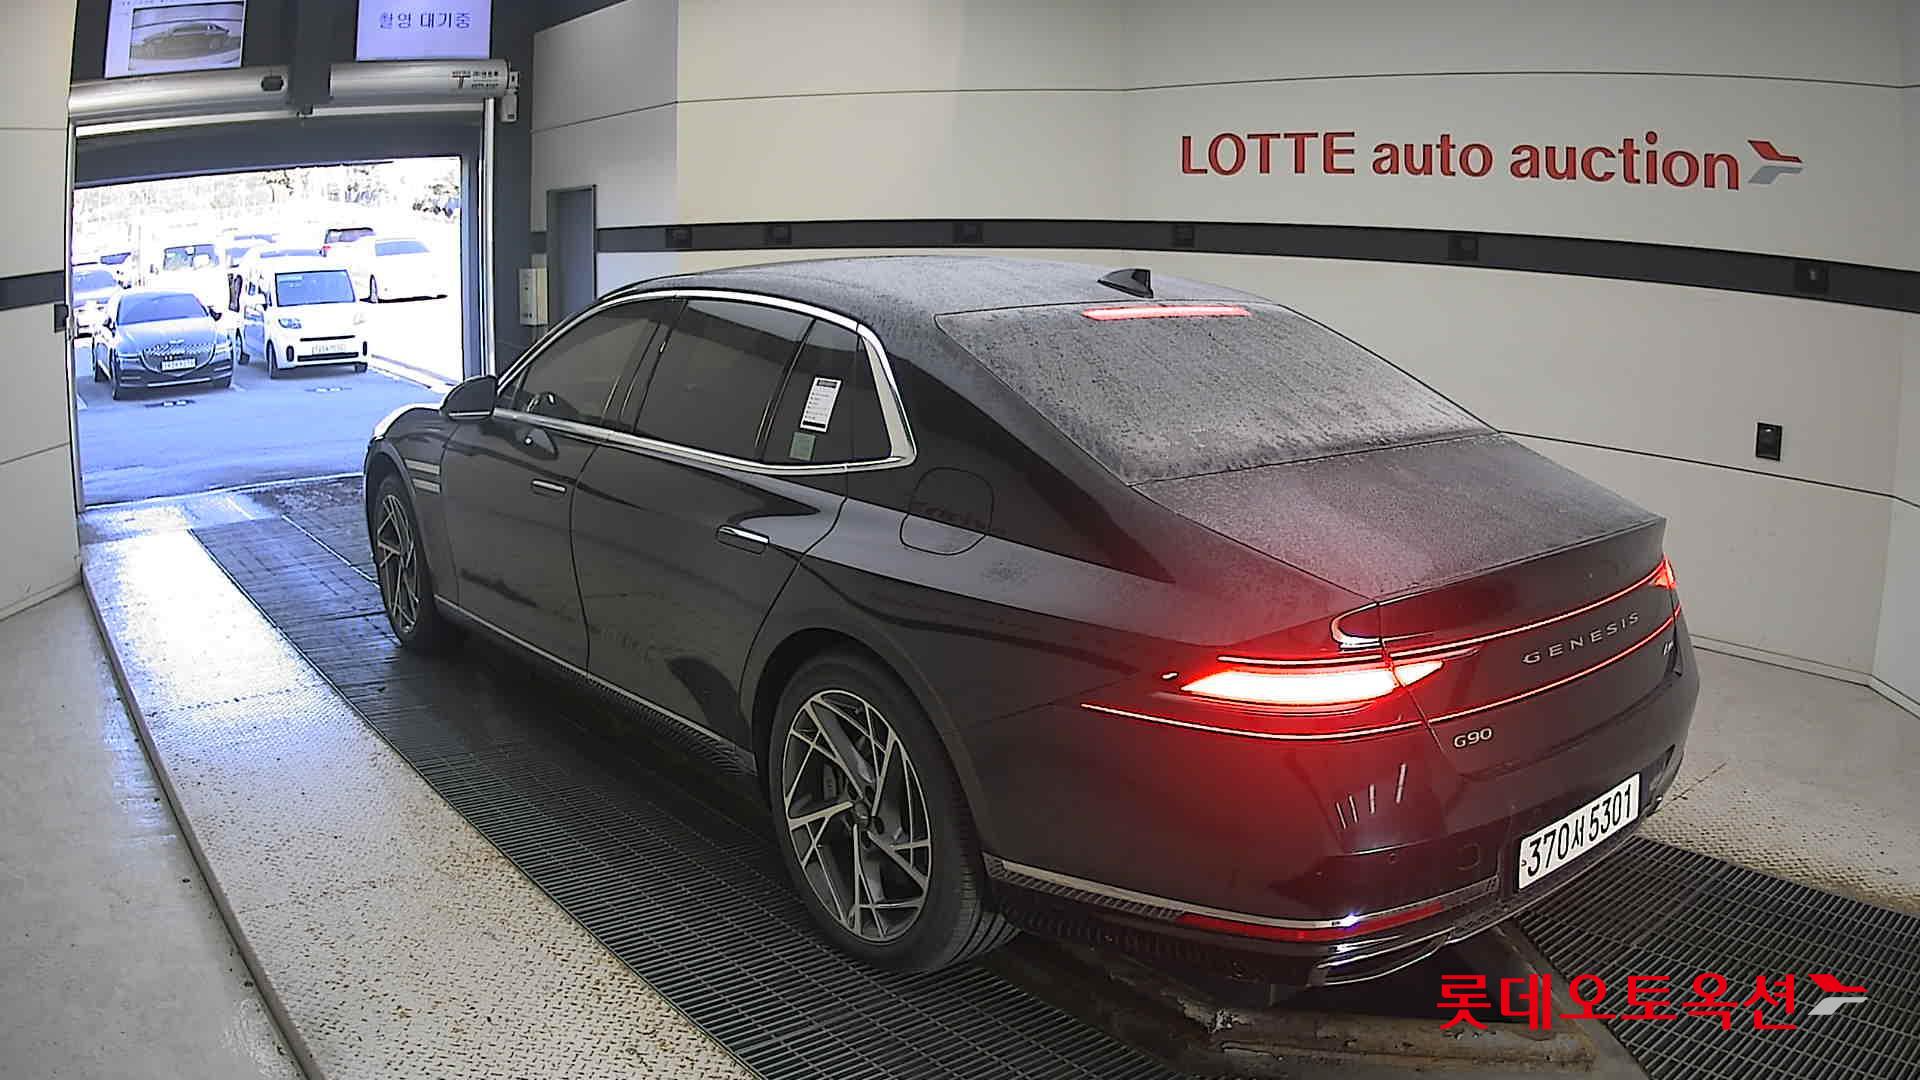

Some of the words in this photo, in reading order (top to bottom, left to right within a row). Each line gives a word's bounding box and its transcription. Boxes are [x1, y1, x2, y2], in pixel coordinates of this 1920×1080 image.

[420, 12, 471, 29] 대기중
[1181, 131, 1356, 175] LOTTE
[1371, 133, 1494, 178] auto
[1510, 130, 1740, 190] auction
[1522, 611, 1641, 665] GENESIS
[1453, 727, 1494, 749] G90
